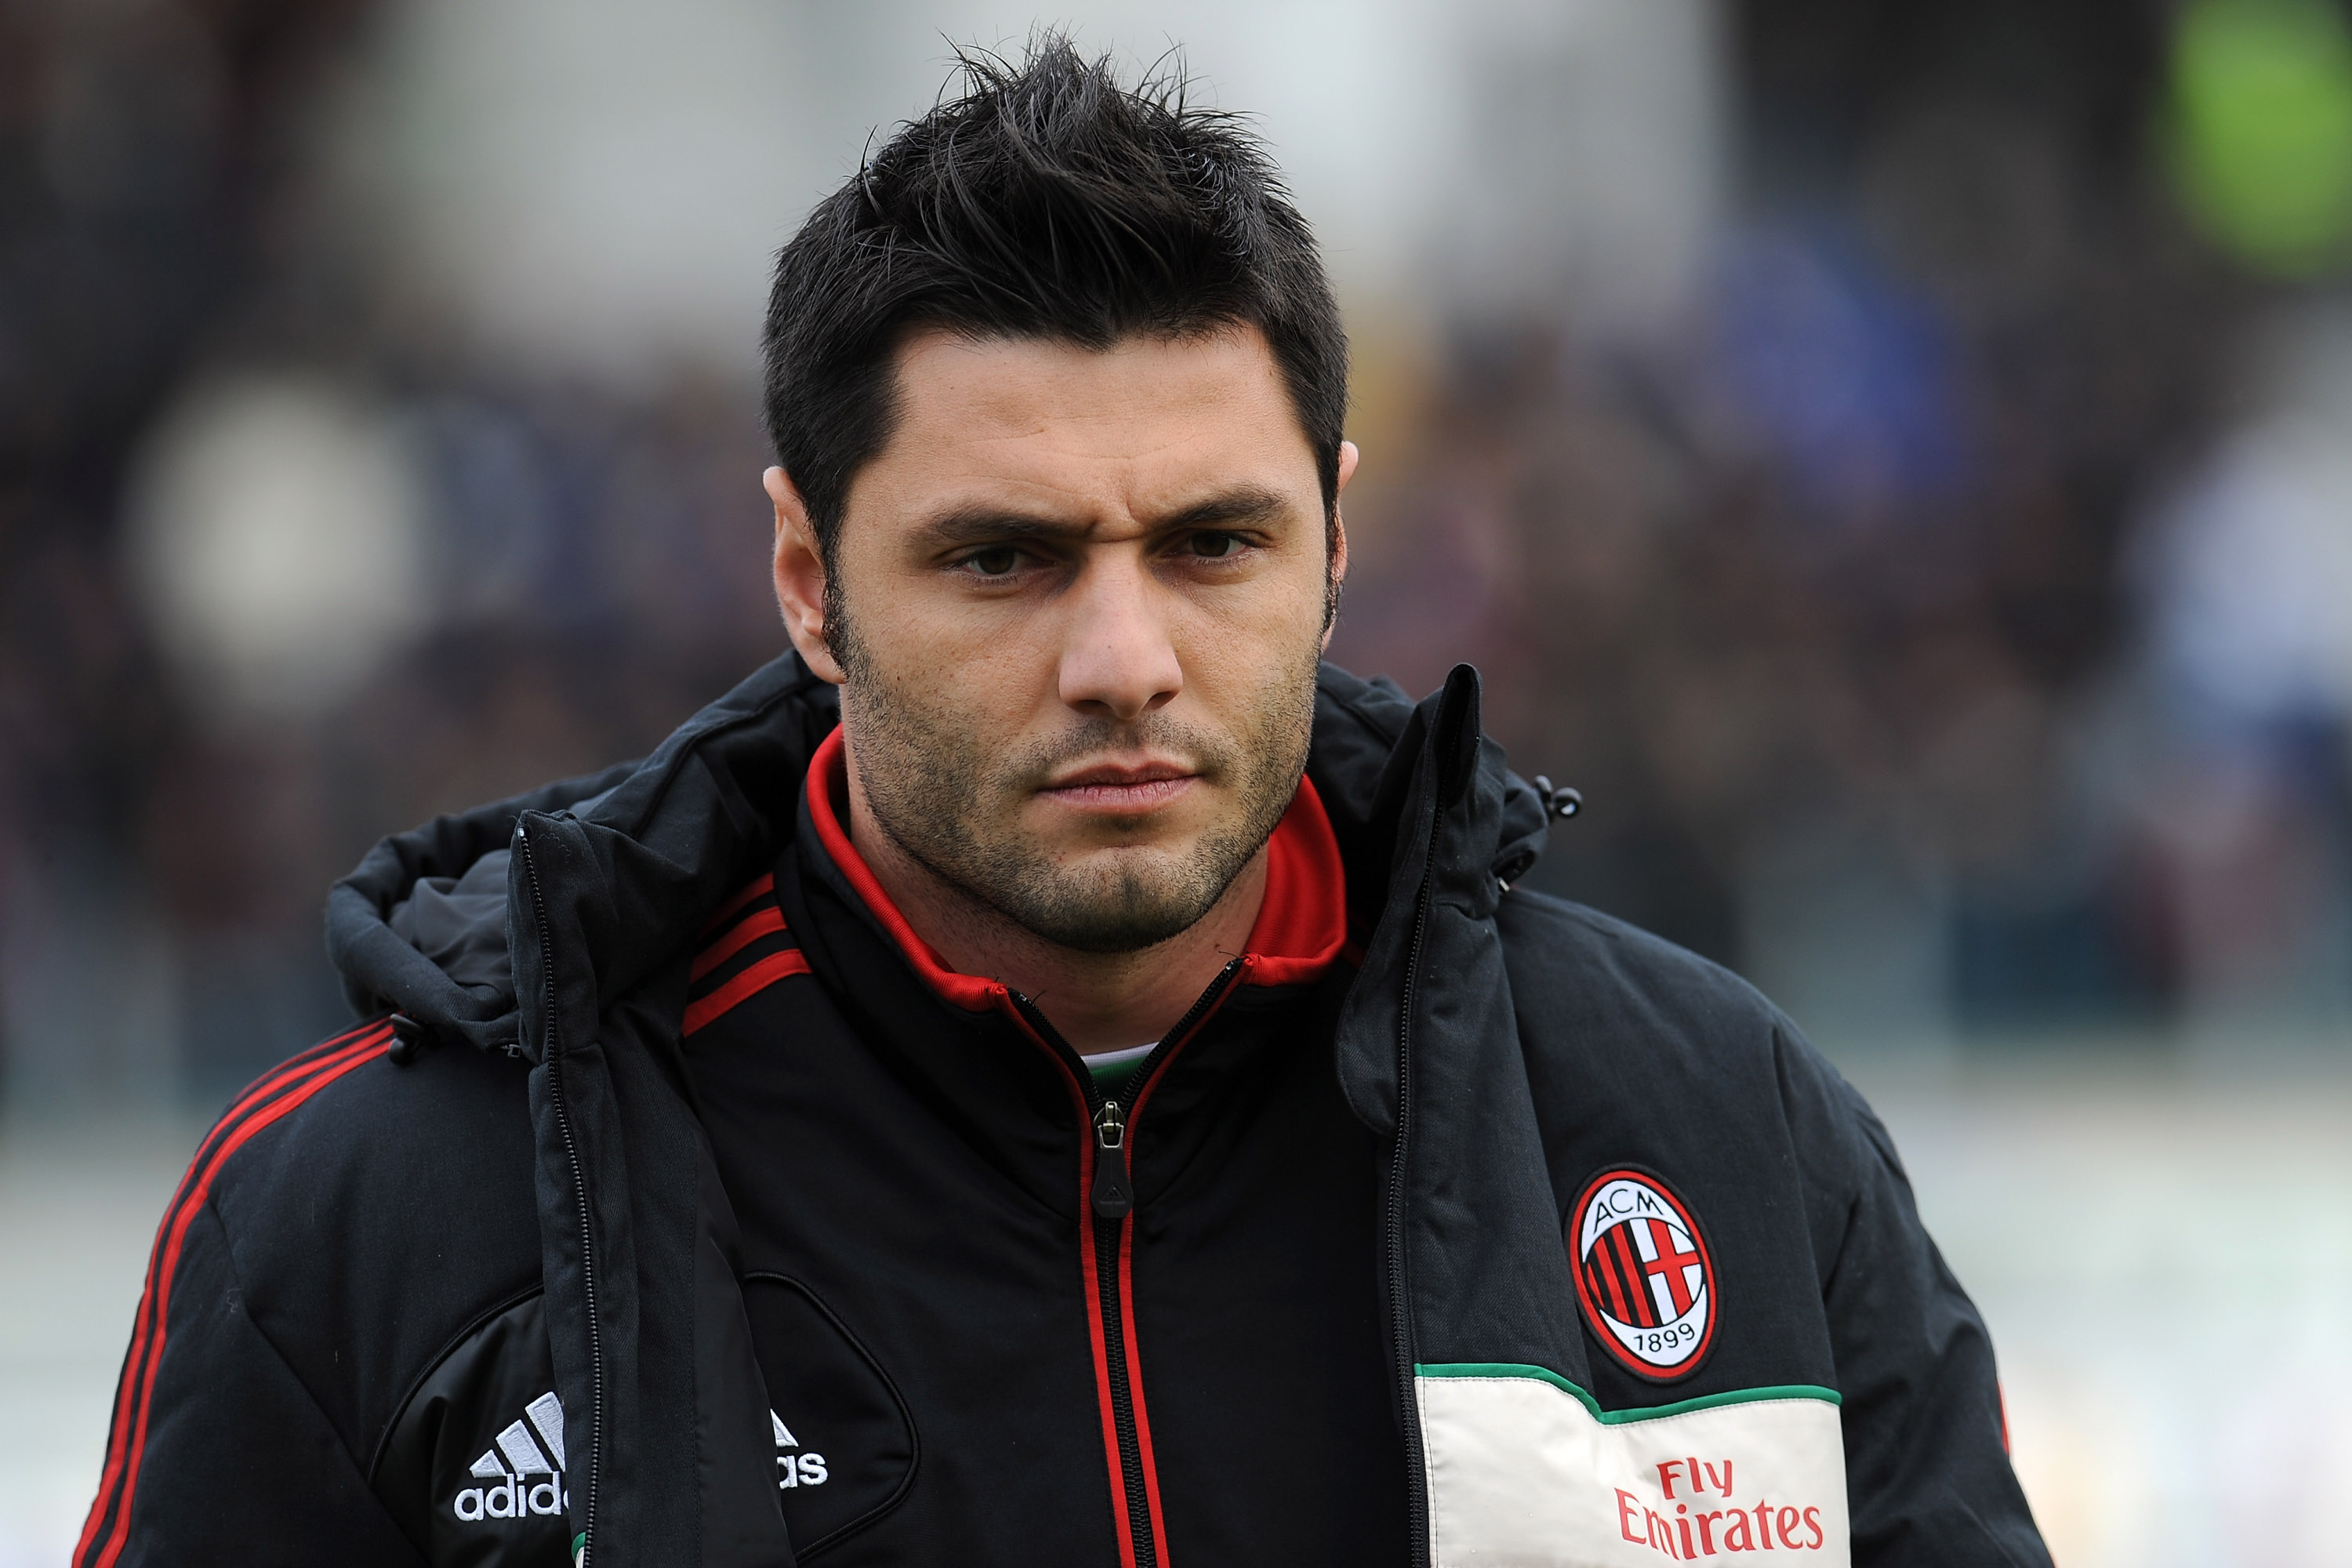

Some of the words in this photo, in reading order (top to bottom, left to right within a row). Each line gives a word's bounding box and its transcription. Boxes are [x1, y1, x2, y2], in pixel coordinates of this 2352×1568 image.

[1593, 1189, 1663, 1235] ACM
[1634, 1323, 1695, 1352] 1899
[453, 1473, 569, 1522] adid
[1656, 1457, 1733, 1501] Fly
[1613, 1486, 1824, 1561] Emirates
